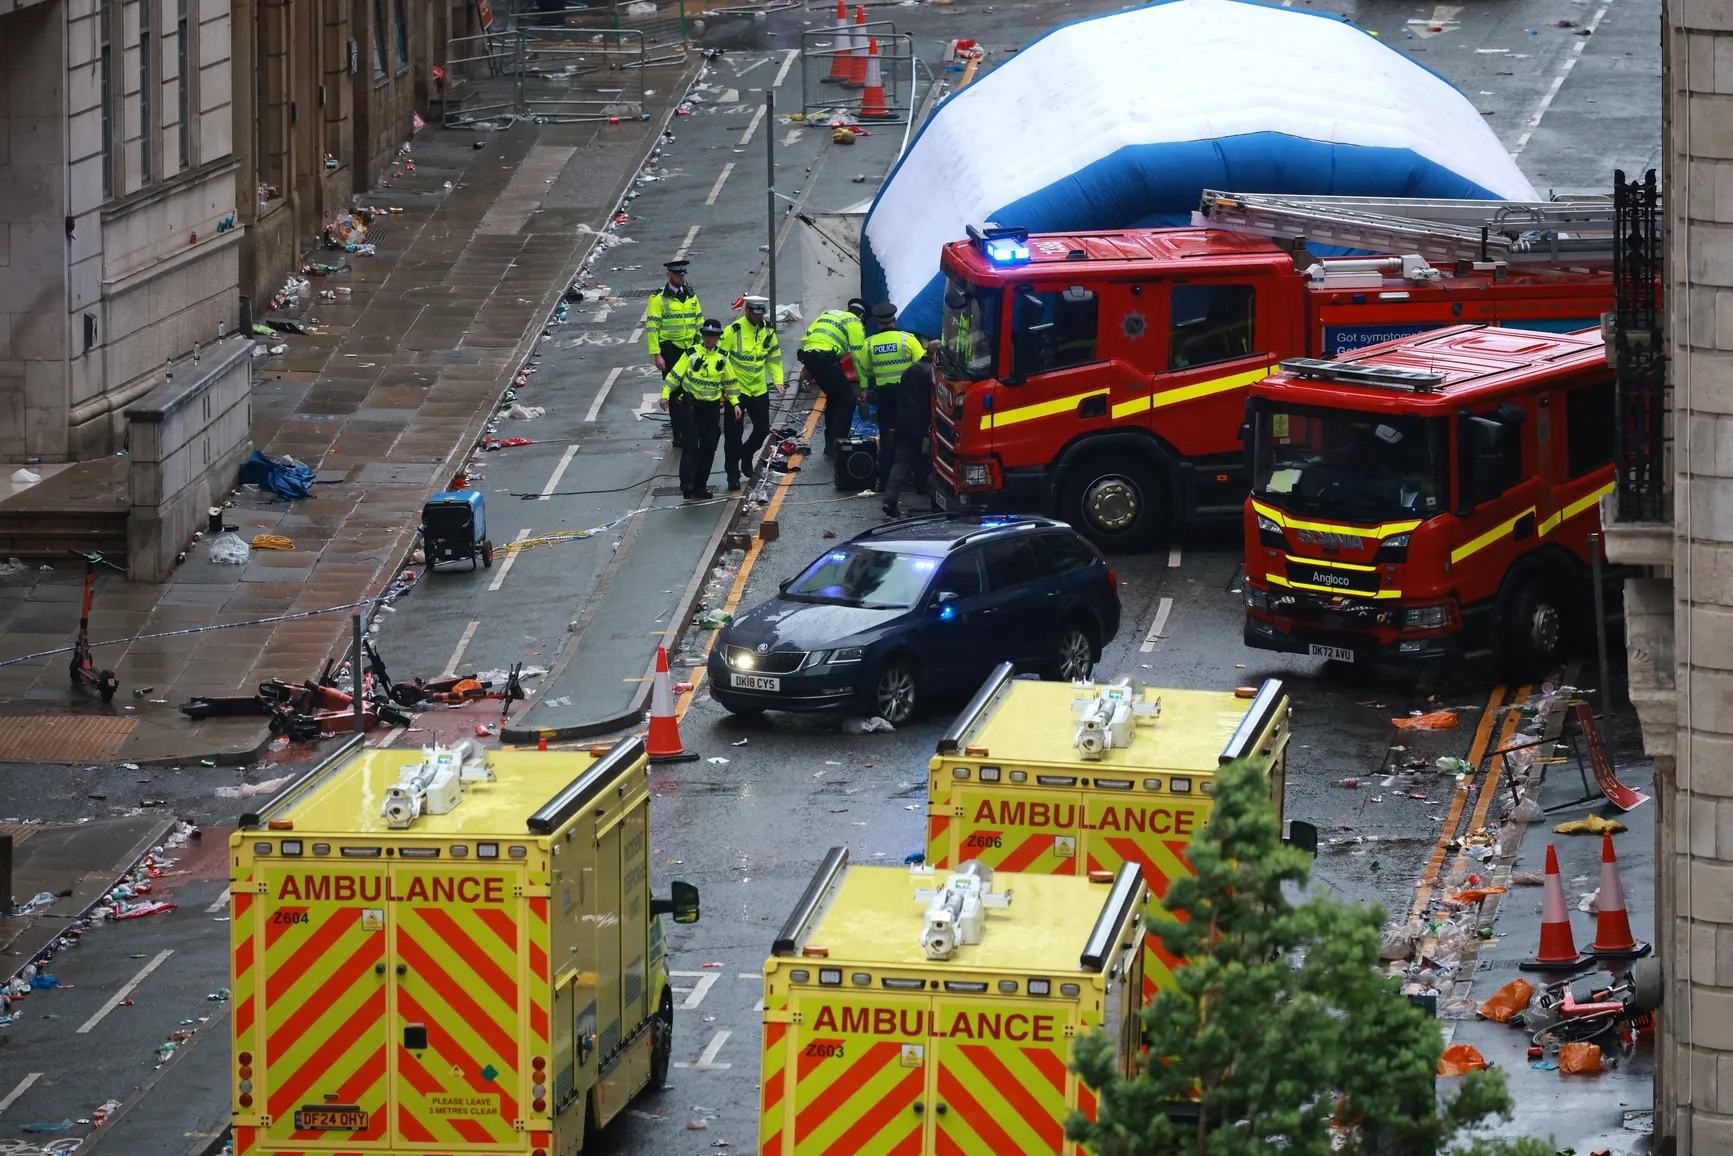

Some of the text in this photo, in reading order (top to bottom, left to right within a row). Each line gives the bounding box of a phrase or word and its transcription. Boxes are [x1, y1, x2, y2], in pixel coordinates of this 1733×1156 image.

[1336, 331, 1424, 344] Got symptom
[874, 344, 897, 354] POLICE
[1298, 530, 1364, 550] SCANIA
[1312, 571, 1350, 586] Angloco
[1312, 645, 1351, 660] DK72 AVU
[735, 675, 775, 690] DK18 CYS
[973, 799, 1195, 835] AMBULANCE
[967, 834, 1003, 849] Z606
[278, 874, 505, 903] AMBULANCE
[273, 911, 309, 925] Z604
[812, 1005, 1055, 1043] AMBULANCE
[806, 1043, 845, 1059] Z603
[432, 1097, 492, 1106] PLEASE LEAVE
[303, 1112, 337, 1126] DF24
[428, 1107, 498, 1116] 3 METRES CLEAR
